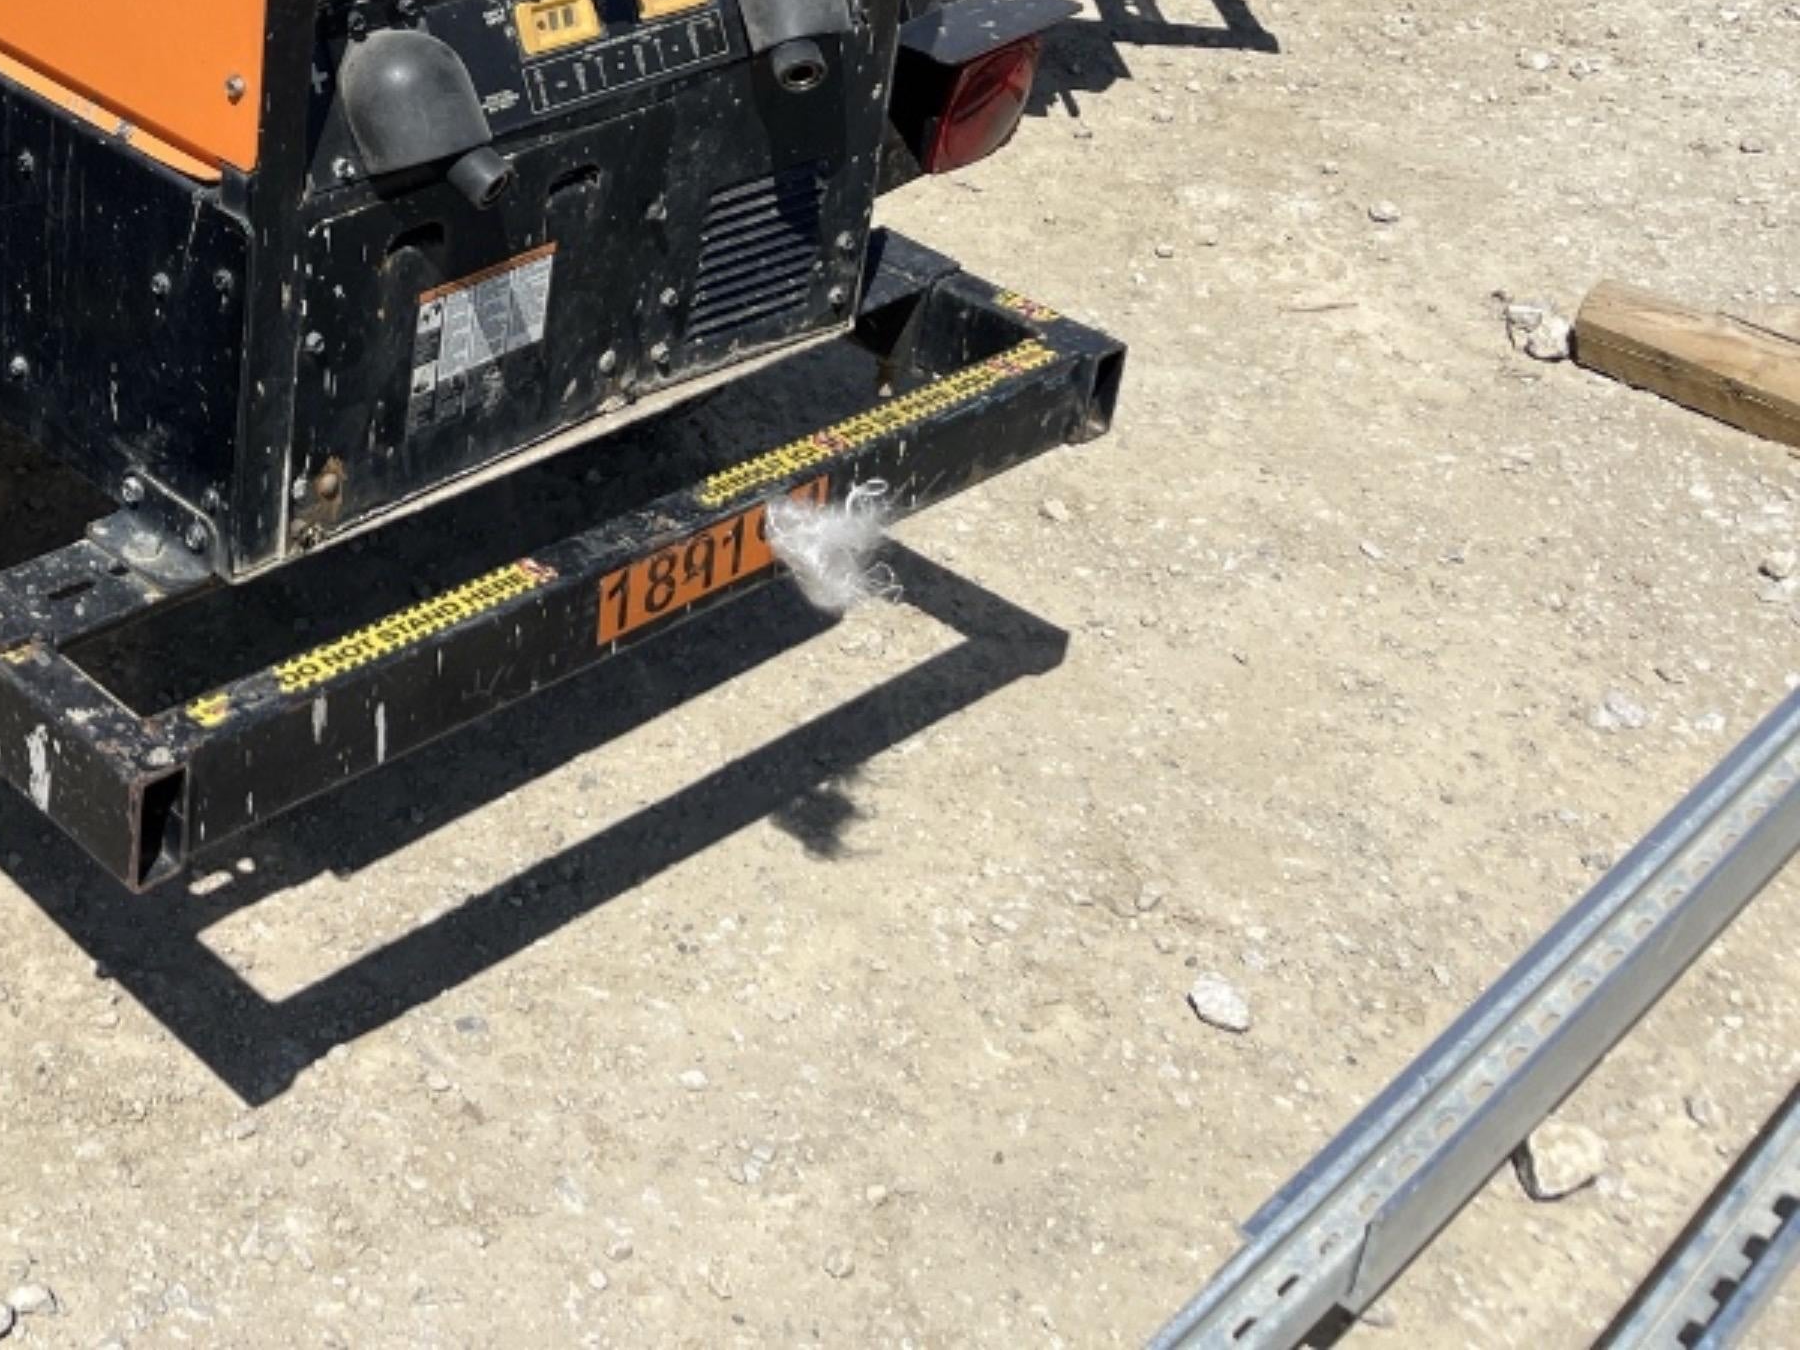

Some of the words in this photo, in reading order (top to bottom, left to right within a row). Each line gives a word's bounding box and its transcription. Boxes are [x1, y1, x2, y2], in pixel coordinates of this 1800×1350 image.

[280, 662, 320, 686] DO
[322, 637, 374, 668] NOT
[375, 599, 462, 641] STAND
